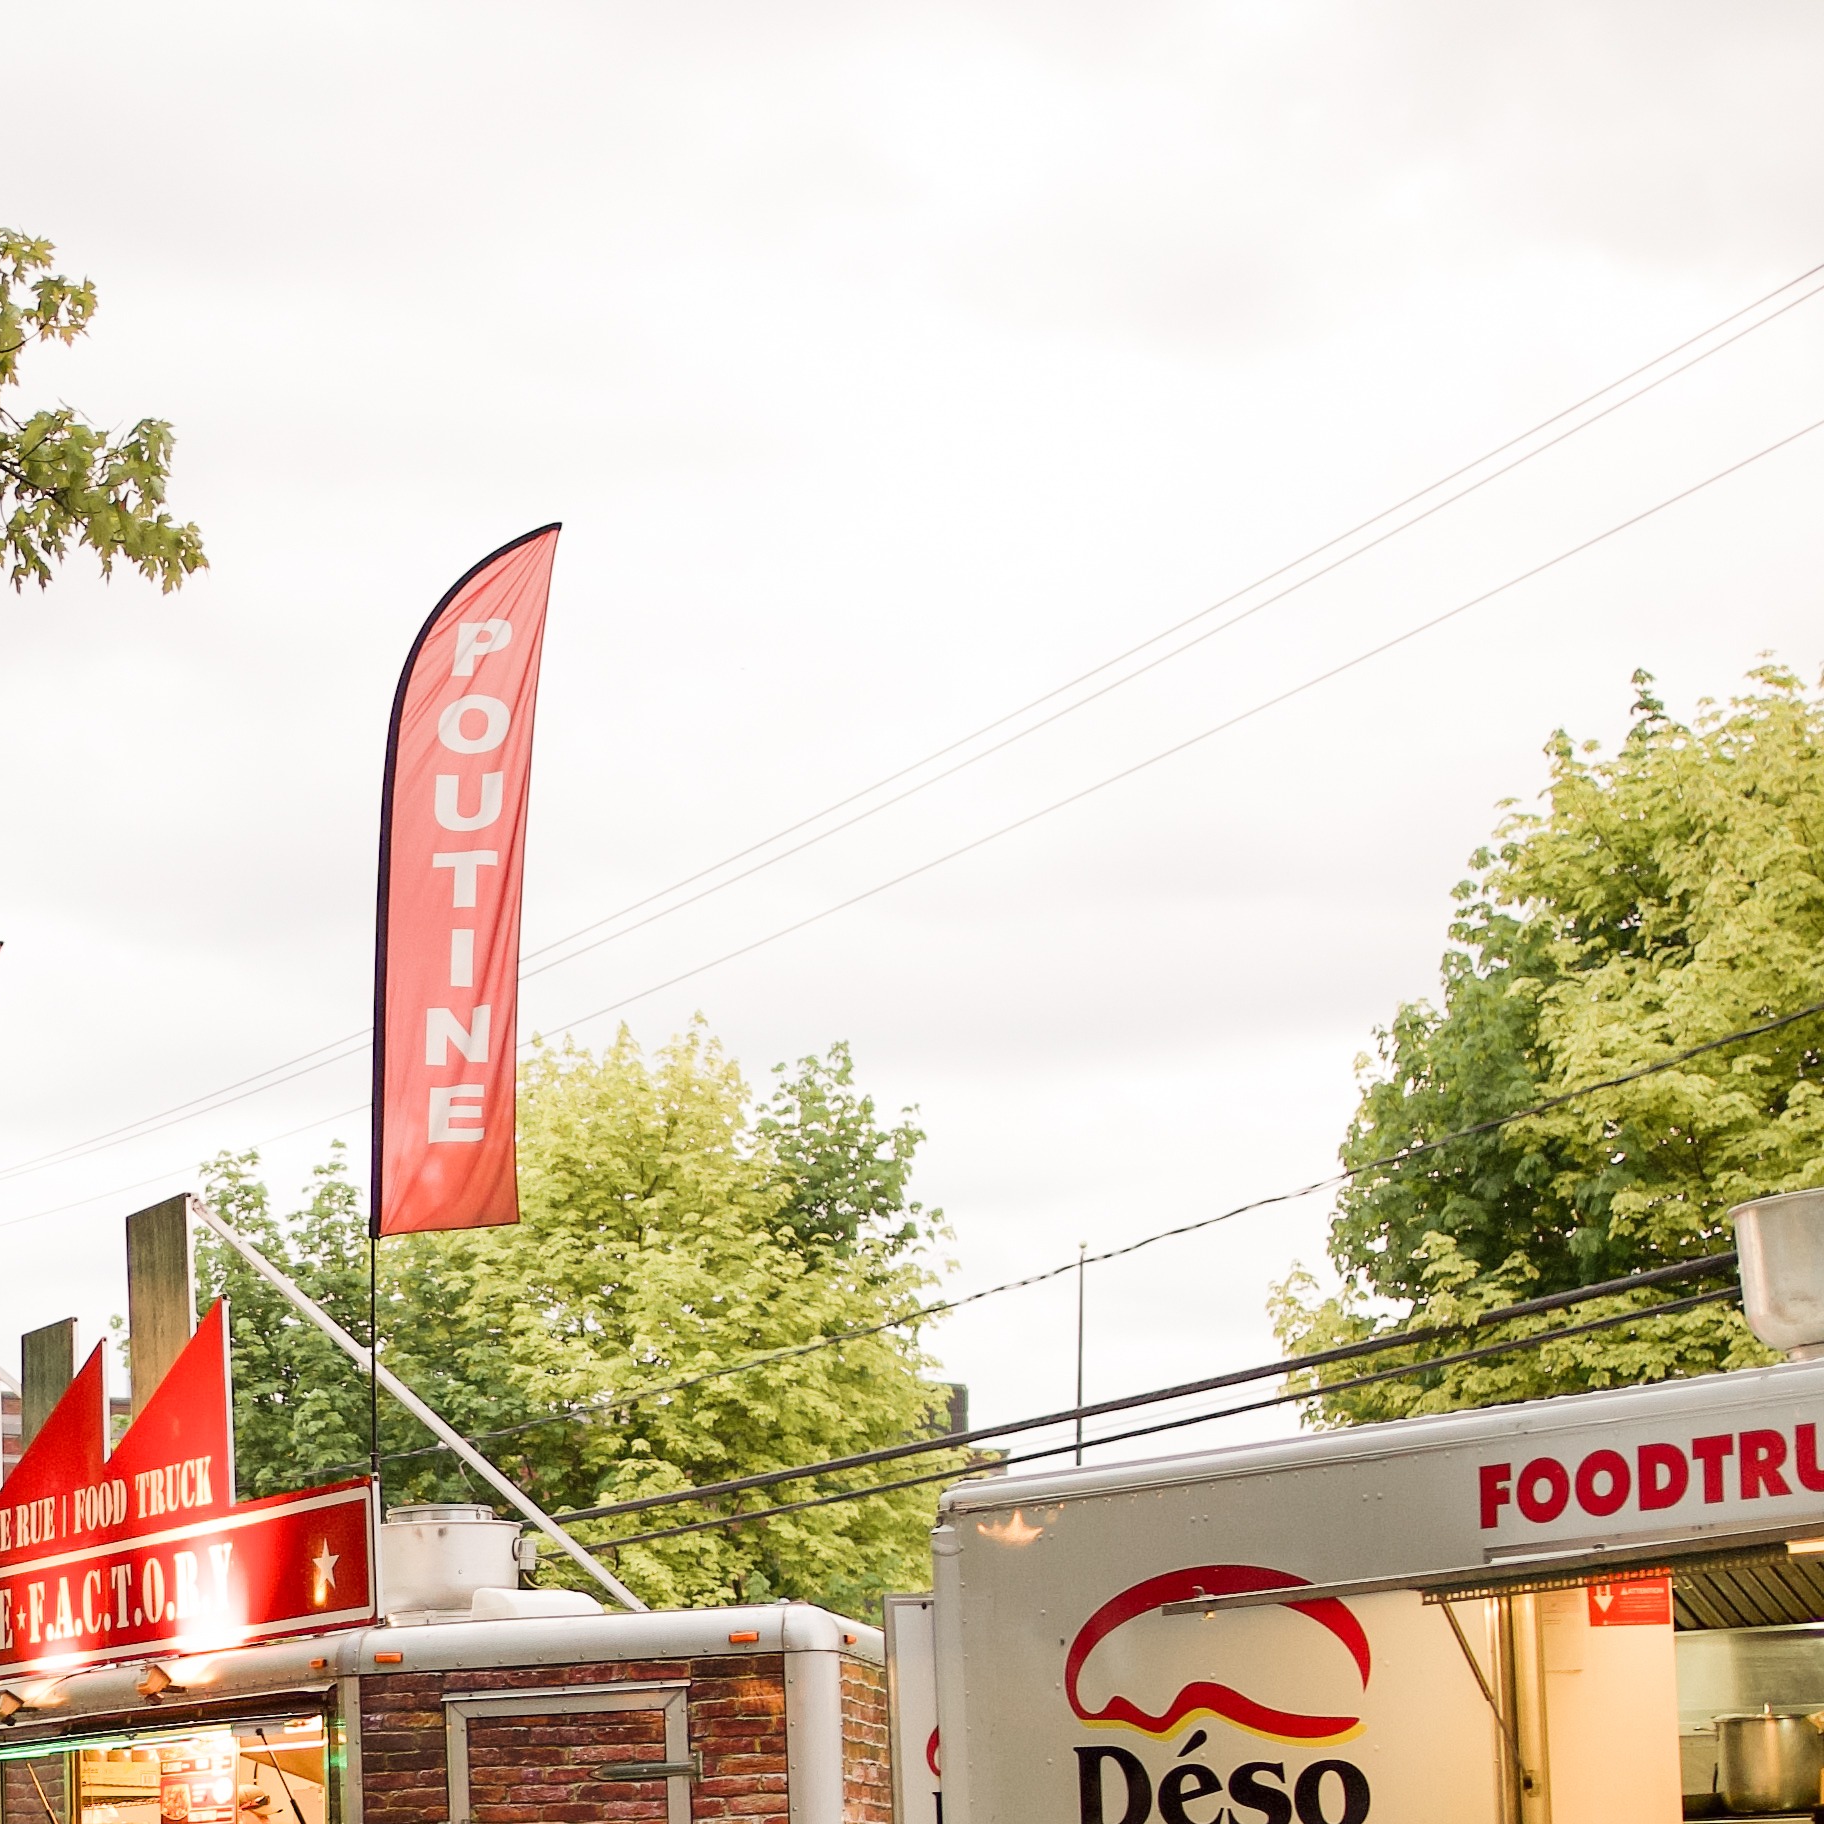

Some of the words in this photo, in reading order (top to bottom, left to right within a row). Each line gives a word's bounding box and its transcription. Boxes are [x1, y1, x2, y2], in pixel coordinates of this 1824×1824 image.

[425, 617, 513, 1144] POUTINE
[16, 1495, 56, 1548] RUE
[74, 1478, 127, 1534] FOOD
[135, 1455, 212, 1519] TRUCK
